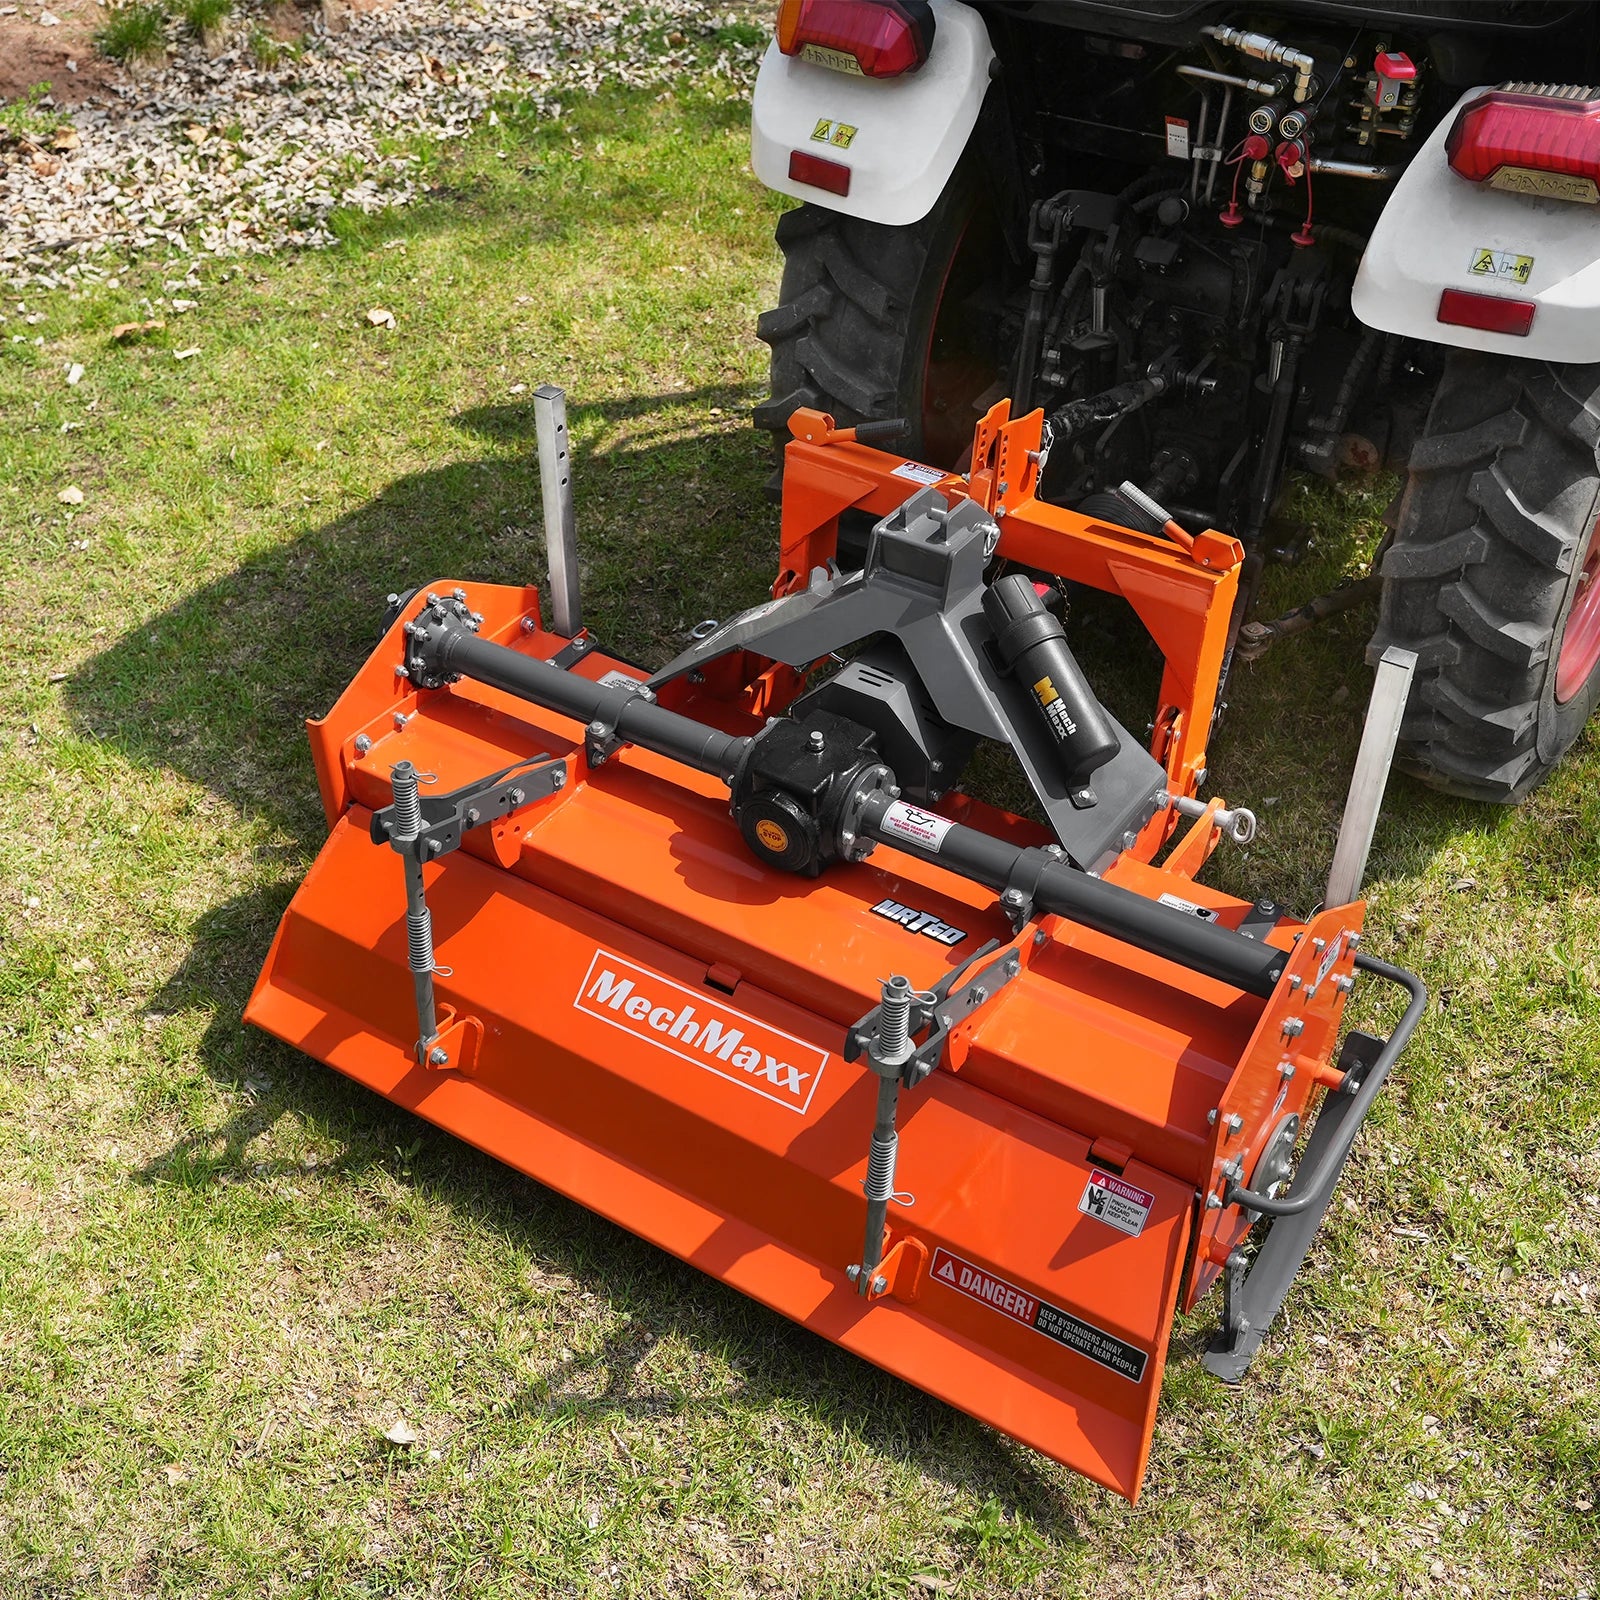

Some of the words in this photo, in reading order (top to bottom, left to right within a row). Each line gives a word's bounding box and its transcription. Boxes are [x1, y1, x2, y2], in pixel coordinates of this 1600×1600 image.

[1046, 703, 1068, 740] Maxx
[1053, 697, 1077, 735] Mech
[870, 898, 967, 946] MRT60
[587, 969, 811, 1095] MechMaxx
[1108, 1180, 1145, 1204] WARNING
[1109, 1205, 1130, 1217] HAZARD
[1111, 1199, 1127, 1209] PINCH
[1127, 1206, 1143, 1217] POINT
[1107, 1210, 1121, 1219] KEEP
[1121, 1216, 1139, 1228] CLEAR
[959, 1267, 1034, 1320] DANGER!
[1037, 1317, 1047, 1328] DO
[1047, 1322, 1062, 1335] NOT
[1062, 1330, 1092, 1351] OPERATE
[1092, 1345, 1111, 1361] NEAR
[1112, 1355, 1138, 1376] PEOPLE.
[1040, 1308, 1057, 1322] KEEP
[1058, 1315, 1101, 1345] BYSTANDERS
[1101, 1340, 1123, 1358] AWAY.
